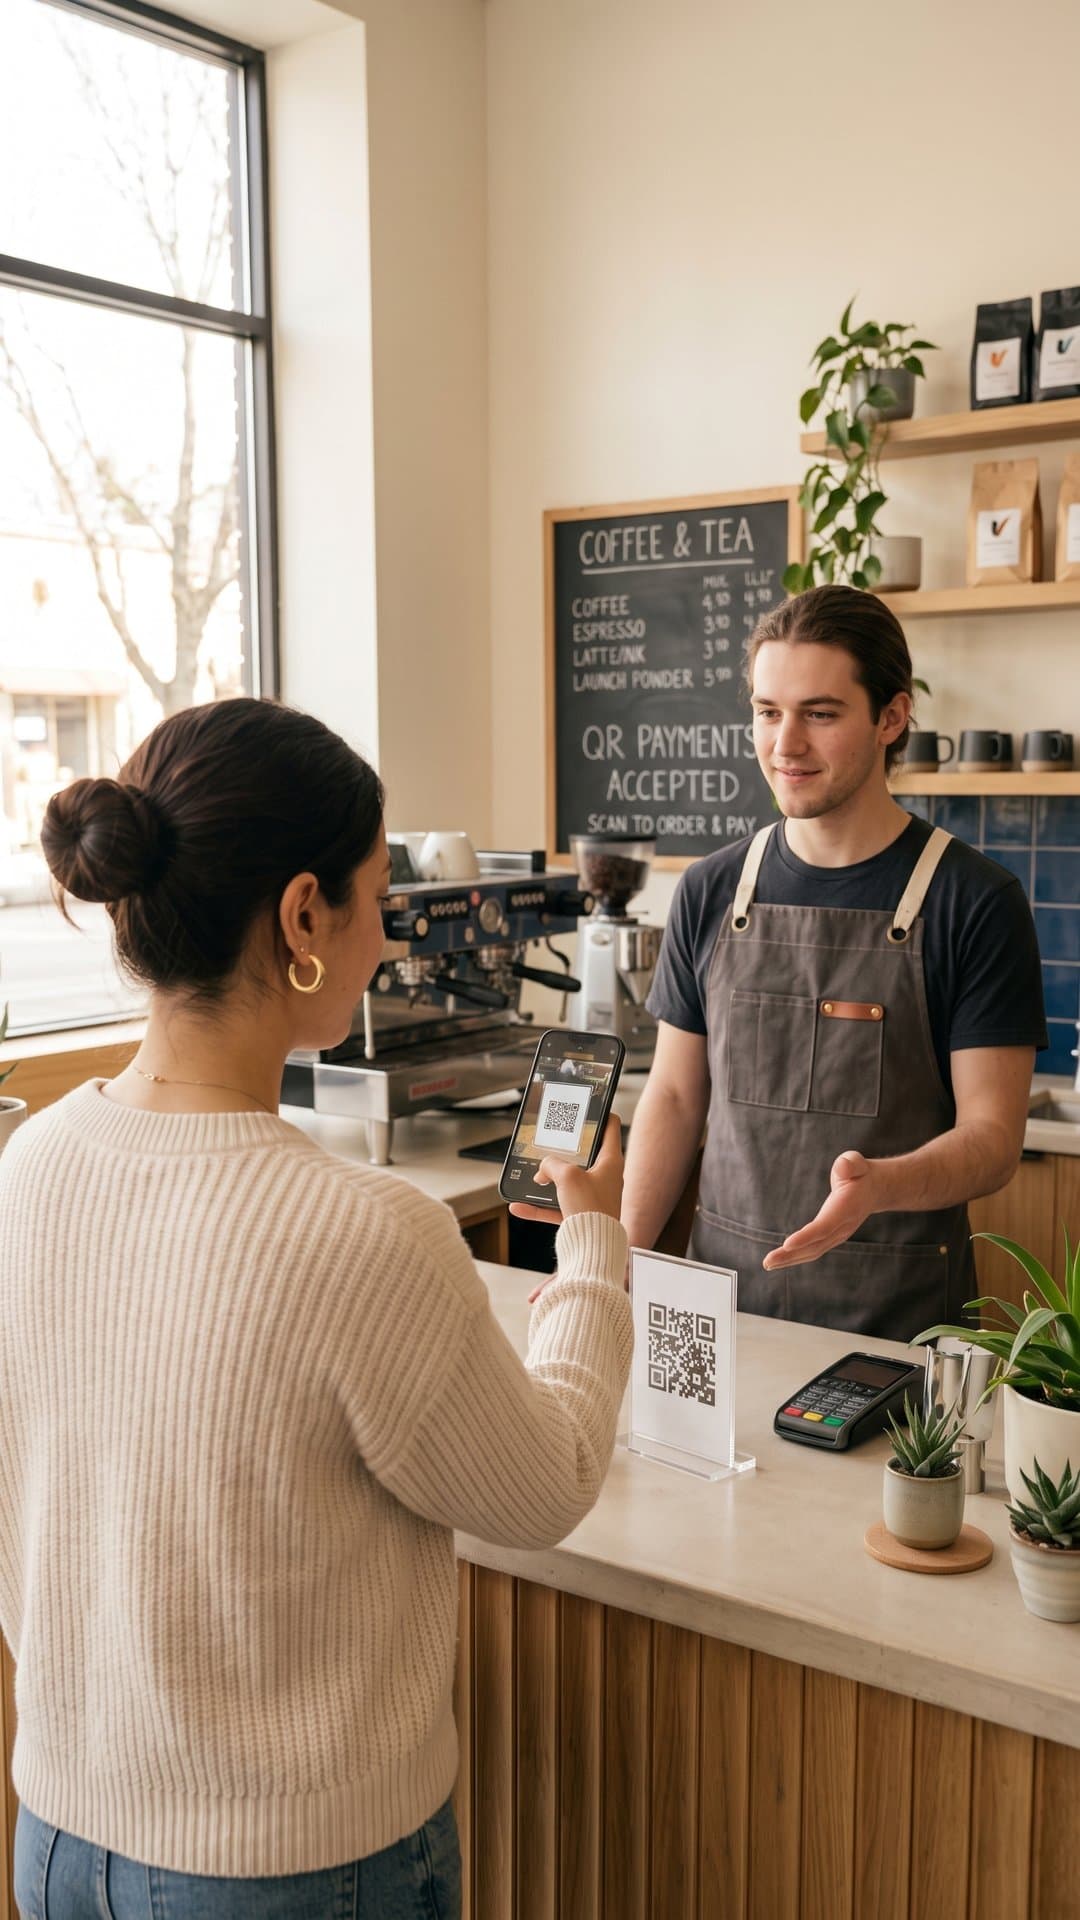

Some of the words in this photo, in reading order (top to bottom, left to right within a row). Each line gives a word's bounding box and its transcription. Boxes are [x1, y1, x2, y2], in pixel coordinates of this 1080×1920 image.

[579, 524, 664, 565] COFFEE
[673, 520, 692, 558] &
[700, 517, 754, 555] TEA
[572, 594, 630, 618] COFFEE
[573, 618, 646, 642] ESPRESSO
[582, 724, 626, 761] QR
[637, 724, 757, 760] PAYMENTS
[606, 769, 740, 803] ACCEPTED
[588, 813, 628, 834] SCAN
[632, 814, 651, 835] TO
[656, 815, 706, 836] ORDER
[711, 814, 722, 836] &
[727, 815, 758, 836] PAY
